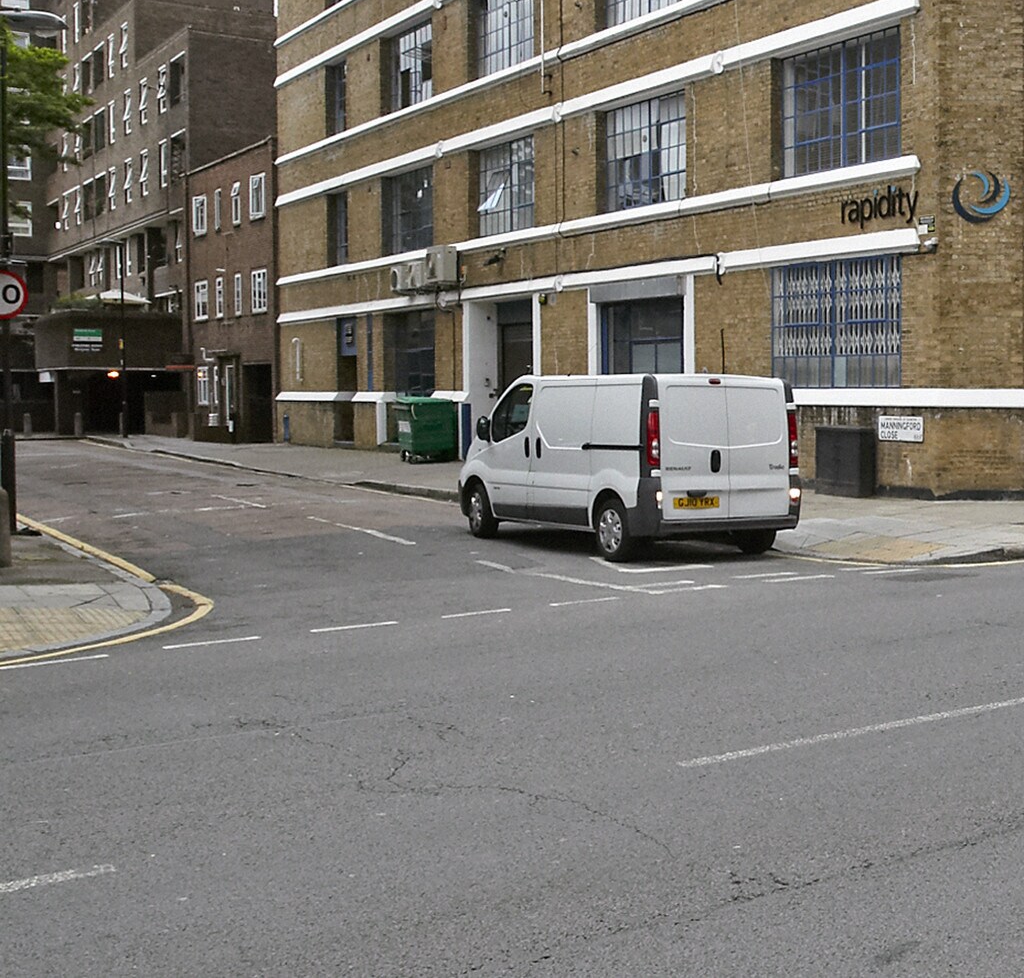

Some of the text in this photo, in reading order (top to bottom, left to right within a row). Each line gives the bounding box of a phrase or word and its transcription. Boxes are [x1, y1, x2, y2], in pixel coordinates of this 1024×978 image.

[841, 185, 918, 229] rapidity
[2, 284, 21, 304] 0
[880, 421, 921, 431] MANNINGFORD
[880, 431, 898, 439] CLOSE
[700, 496, 715, 507] YRX
